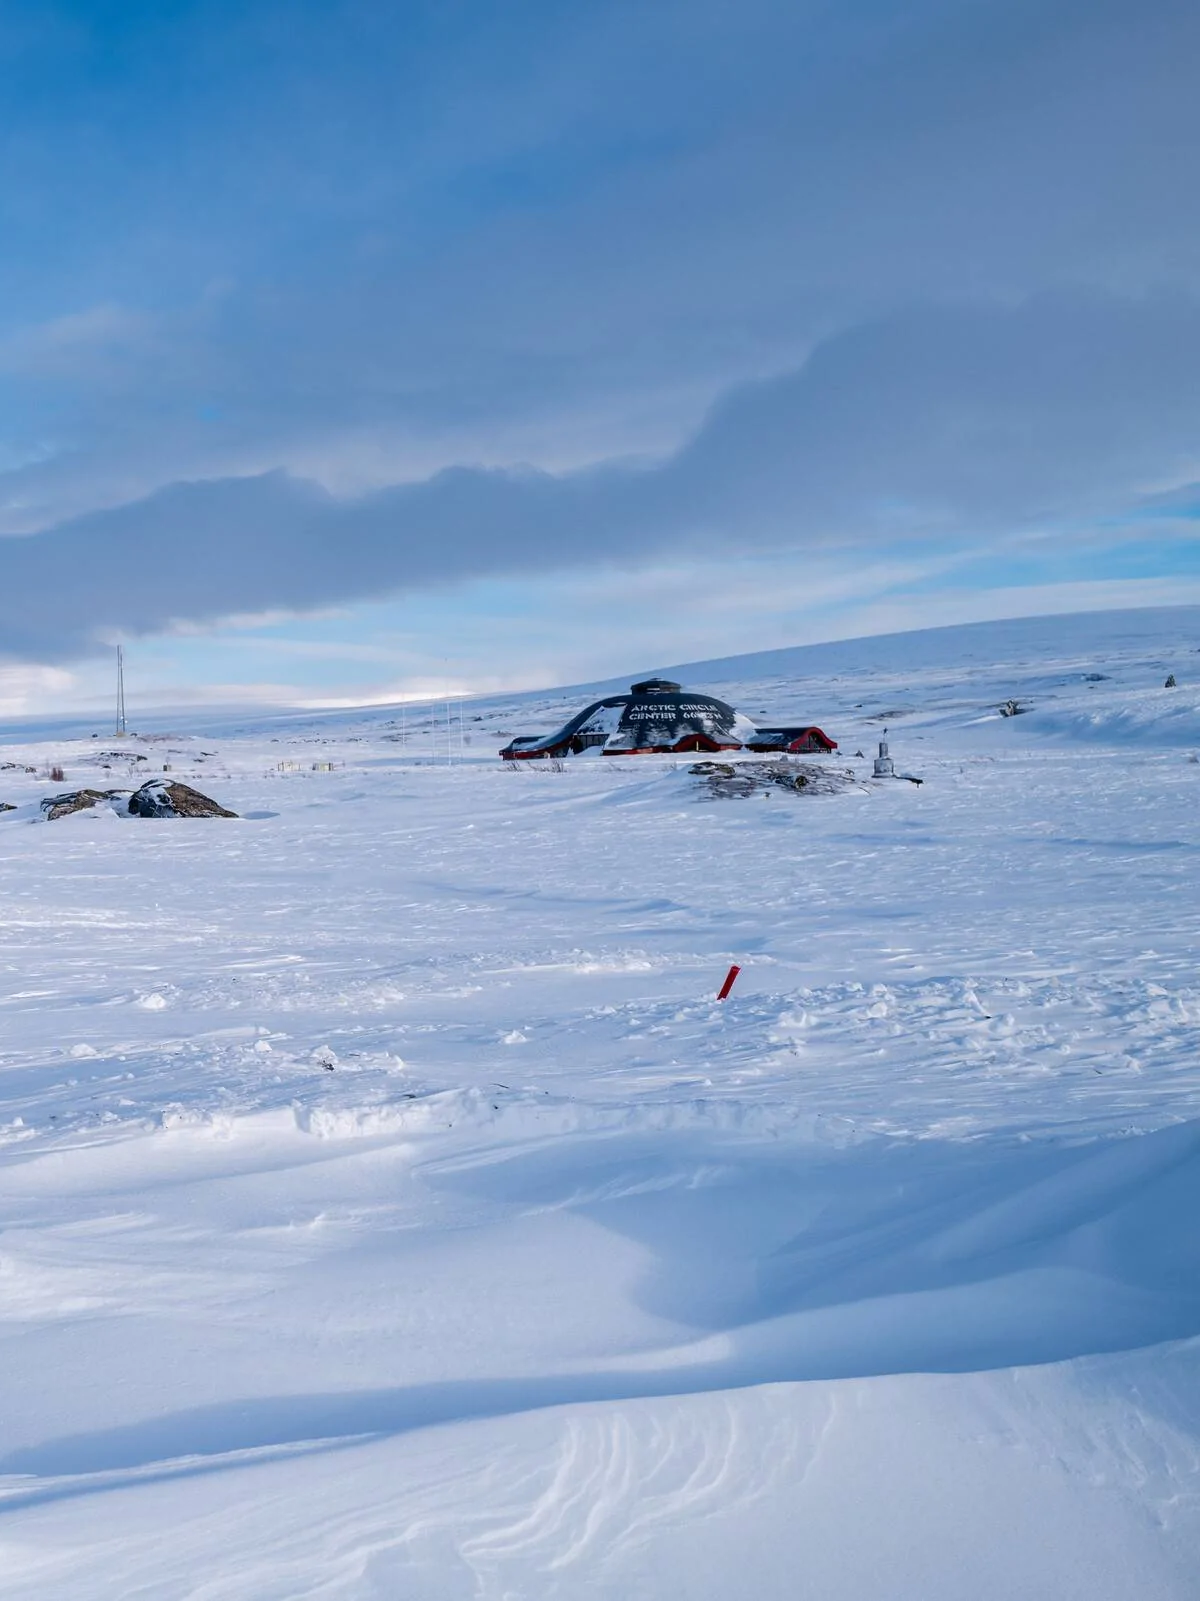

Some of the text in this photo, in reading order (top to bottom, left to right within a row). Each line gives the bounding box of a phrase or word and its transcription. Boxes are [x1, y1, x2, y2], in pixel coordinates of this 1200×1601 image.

[631, 704, 719, 712] ARCTIC CIRCLE
[629, 712, 677, 720] CENTER
